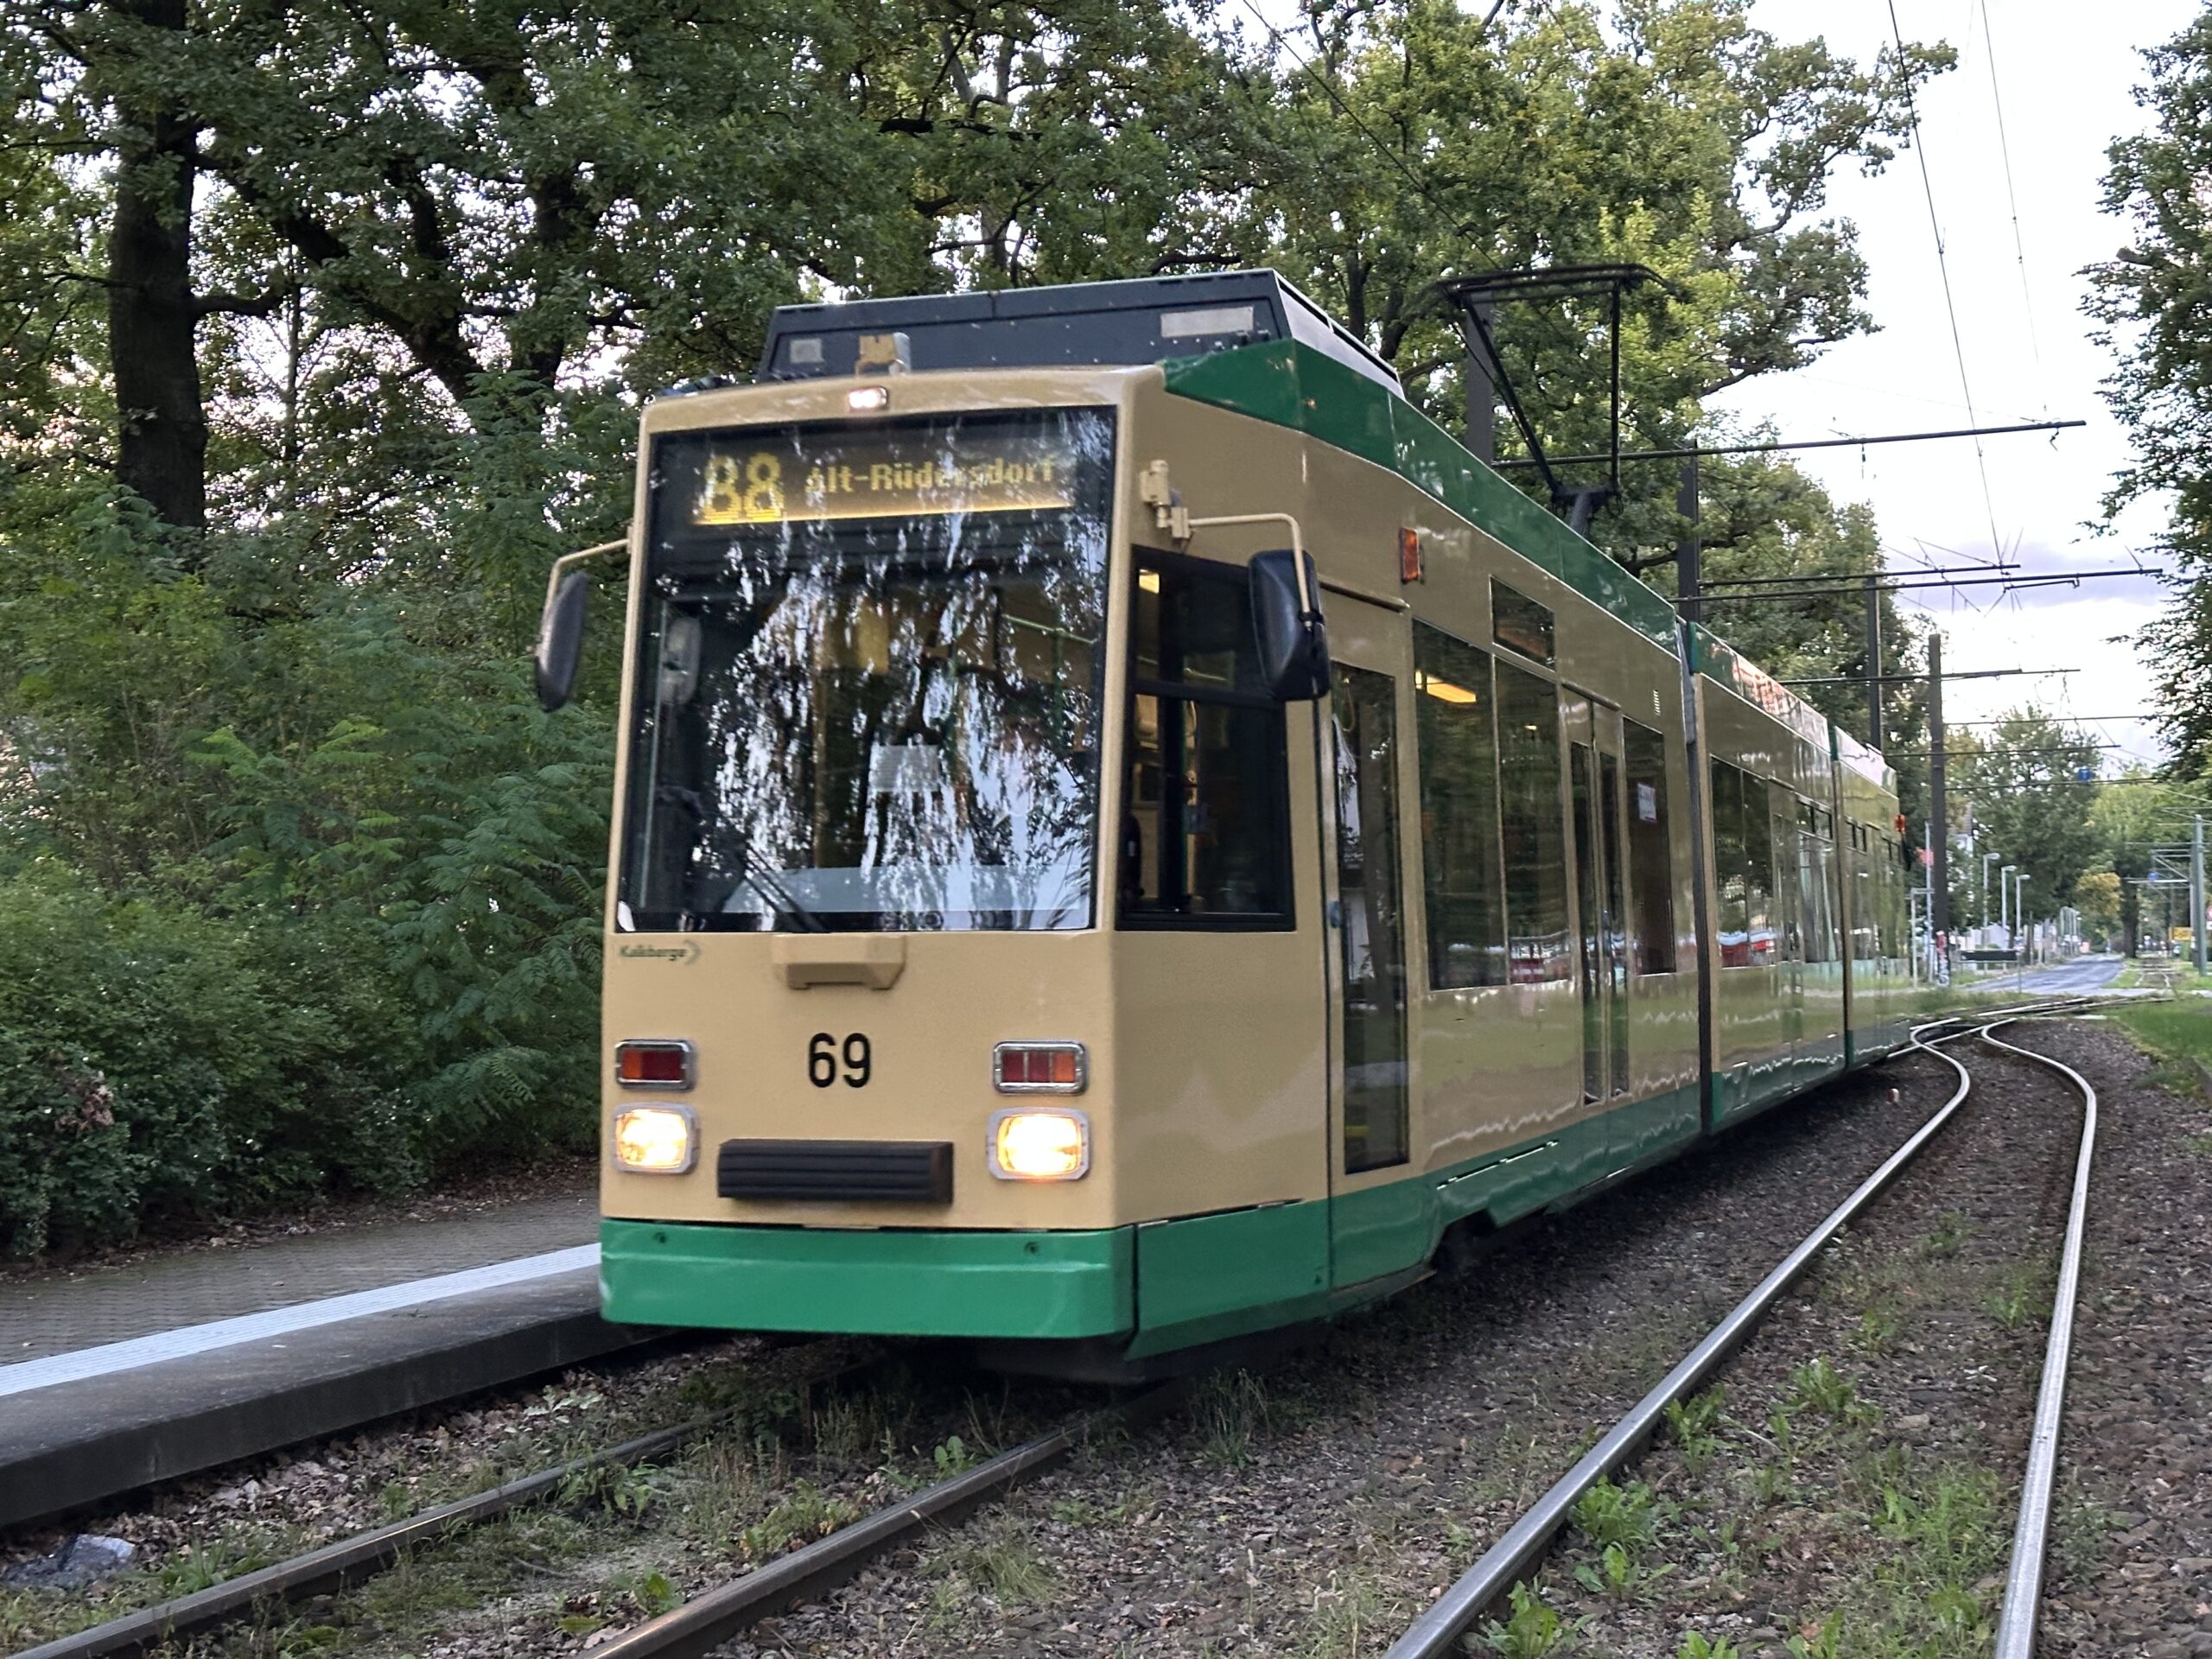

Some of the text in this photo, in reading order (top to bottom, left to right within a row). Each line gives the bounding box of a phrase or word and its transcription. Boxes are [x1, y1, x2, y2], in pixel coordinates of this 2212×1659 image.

[702, 453, 1054, 521] 88 Alt-Rüdersdorf
[808, 1033, 872, 1089] 69
